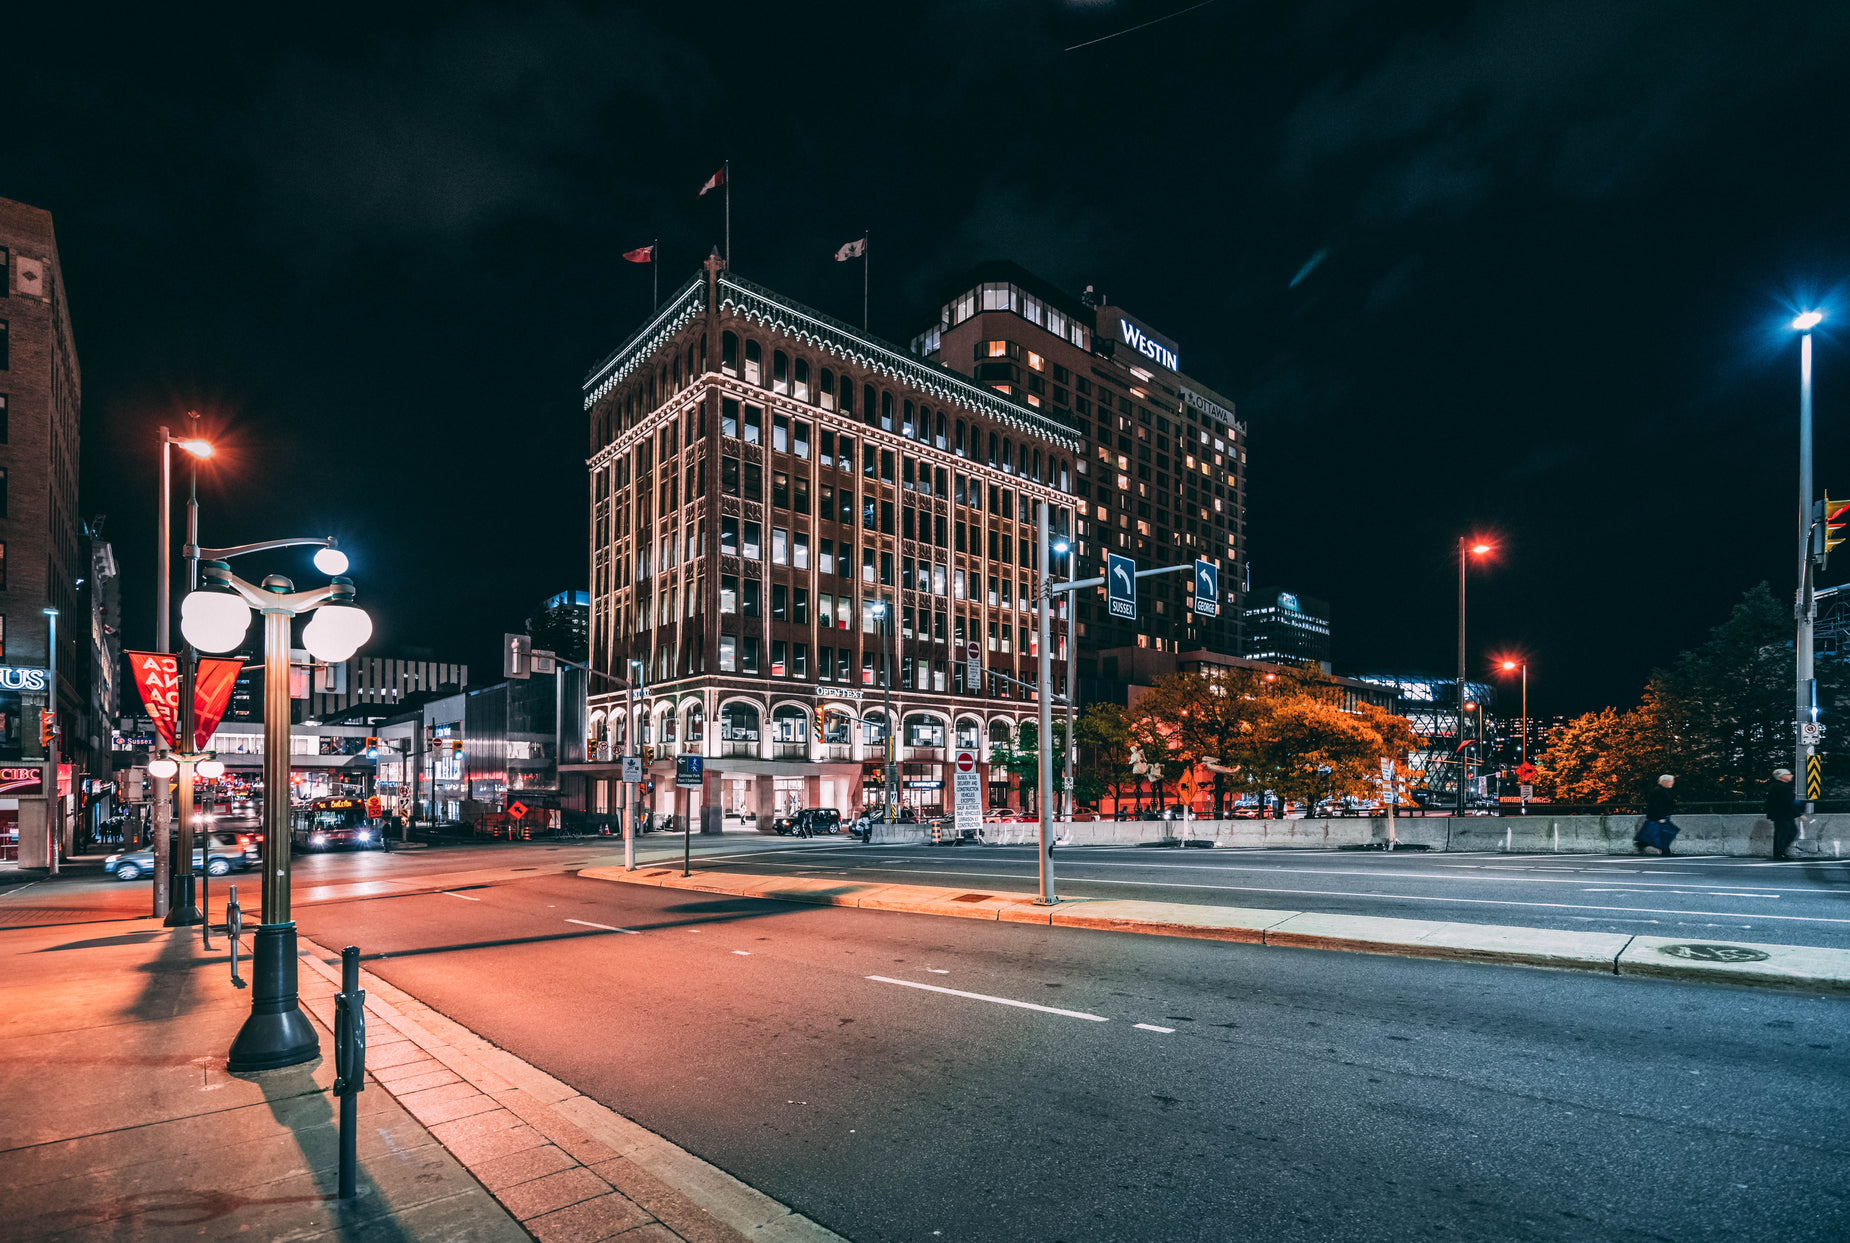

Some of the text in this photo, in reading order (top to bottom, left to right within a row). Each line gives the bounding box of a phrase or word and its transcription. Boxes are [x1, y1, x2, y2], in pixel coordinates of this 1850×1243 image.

[1121, 319, 1177, 371] WESTIN
[1196, 397, 1229, 423] OTTAWA
[1113, 601, 1133, 616] SUSSEX
[1197, 601, 1215, 614] GEORGE
[0, 768, 40, 780] CIBC
